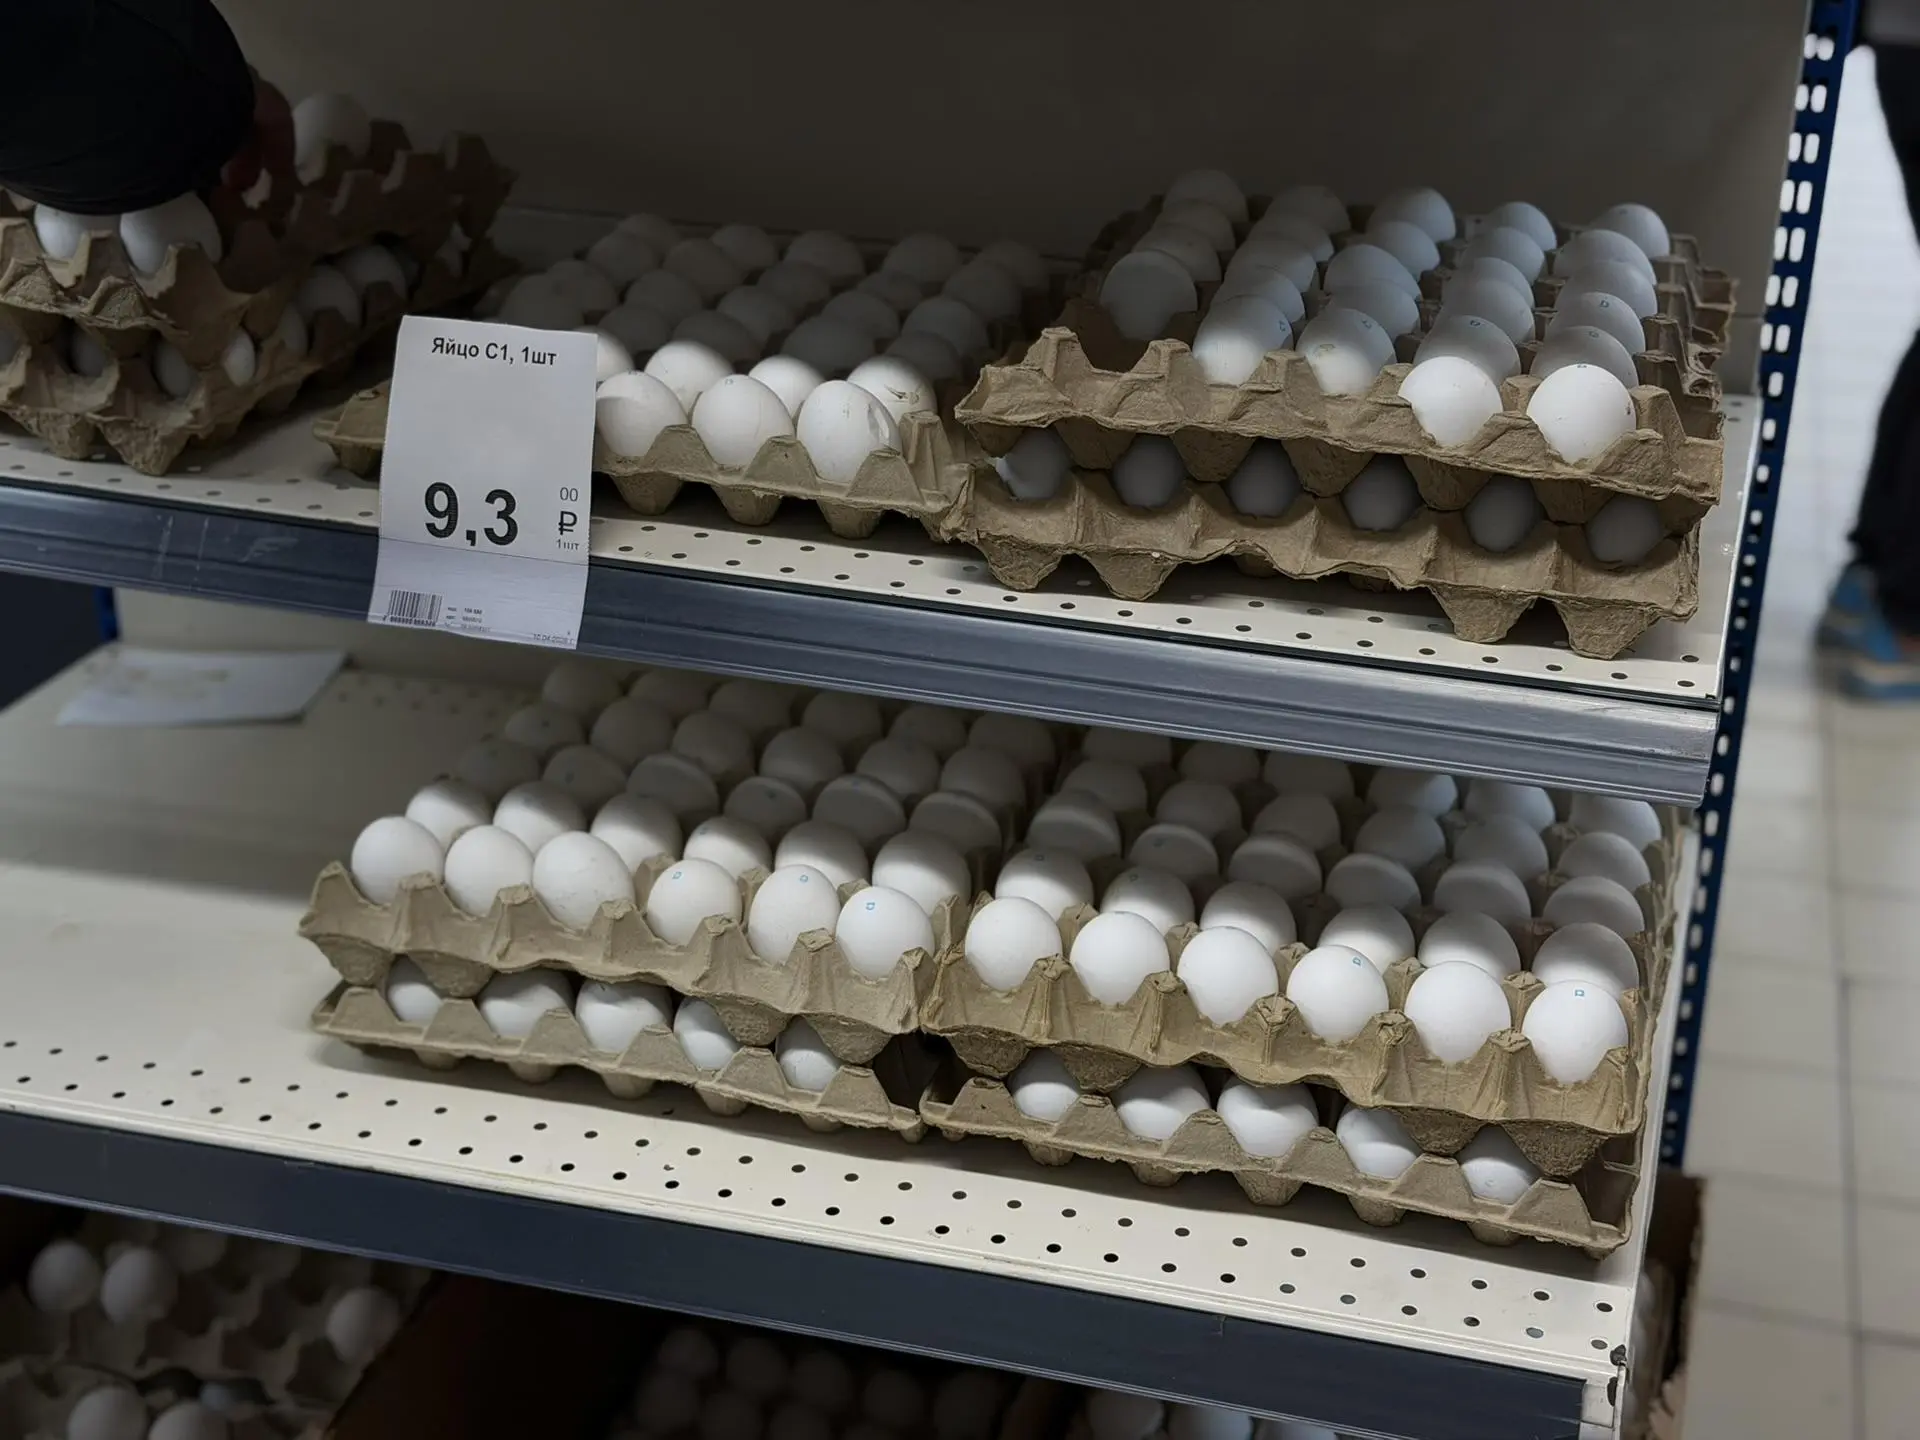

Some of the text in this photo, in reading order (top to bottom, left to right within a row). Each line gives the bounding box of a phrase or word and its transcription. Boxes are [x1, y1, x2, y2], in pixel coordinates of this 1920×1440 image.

[431, 336, 558, 366] Яйцо С1, 1шт
[559, 486, 579, 502] 00
[424, 481, 519, 547] 9,3
[556, 538, 580, 551] 1шт
